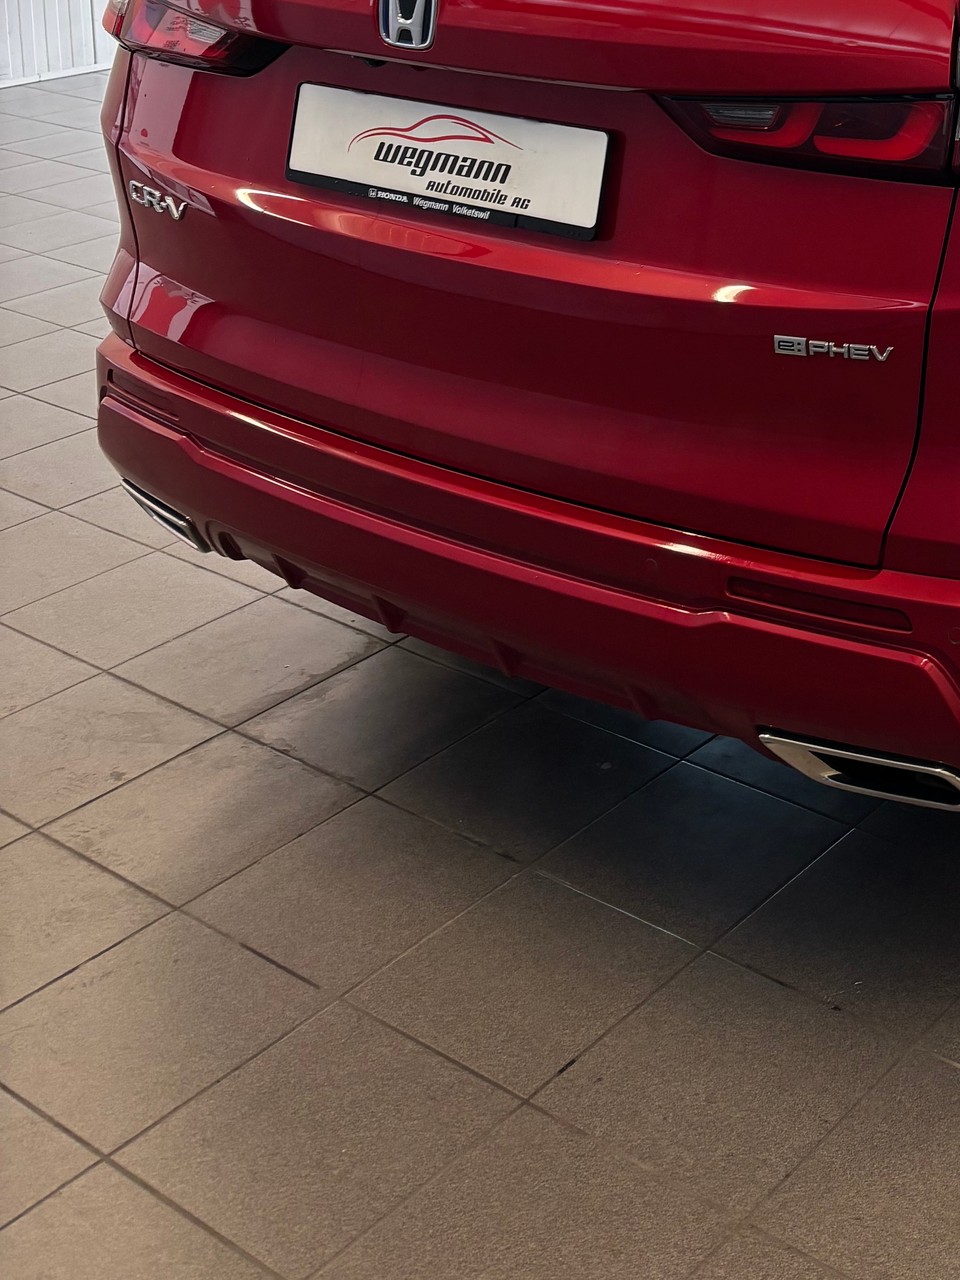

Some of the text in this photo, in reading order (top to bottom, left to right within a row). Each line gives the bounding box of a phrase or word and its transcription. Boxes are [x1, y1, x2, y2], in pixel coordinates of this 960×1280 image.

[129, 180, 188, 221] CR-V
[377, 190, 409, 203] HONDA
[412, 196, 449, 211] Wegmann
[452, 204, 491, 220] Volketswil
[510, 196, 532, 210] AG
